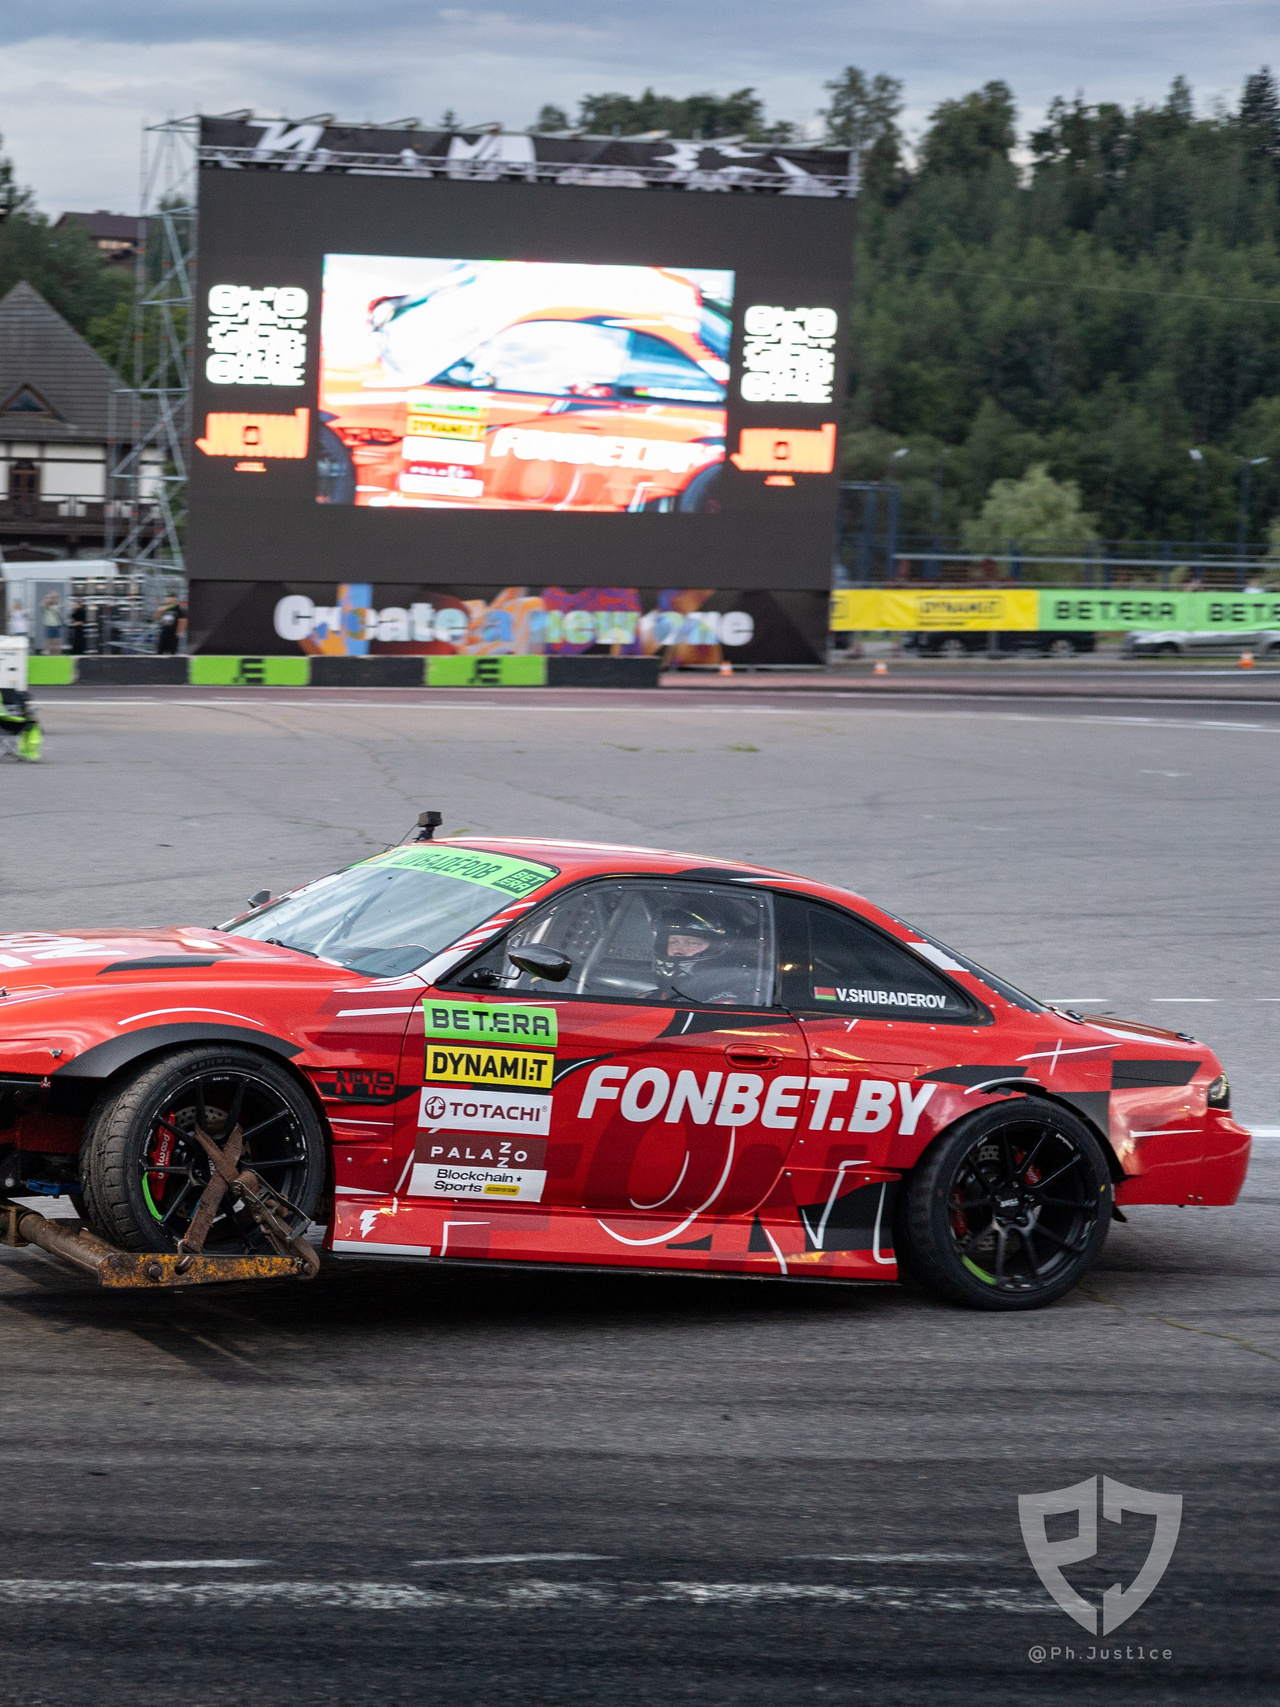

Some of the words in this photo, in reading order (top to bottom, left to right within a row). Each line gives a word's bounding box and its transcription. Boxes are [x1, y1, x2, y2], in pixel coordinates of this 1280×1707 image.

[836, 987, 946, 1008] V.SHUBADEROV
[576, 1064, 938, 1136] FONBET.BY
[450, 1102, 540, 1122] TOTACHI
[430, 1141, 528, 1168] PALAZZO
[437, 1168, 513, 1182] Blockchain
[433, 1180, 483, 1193] Sports
